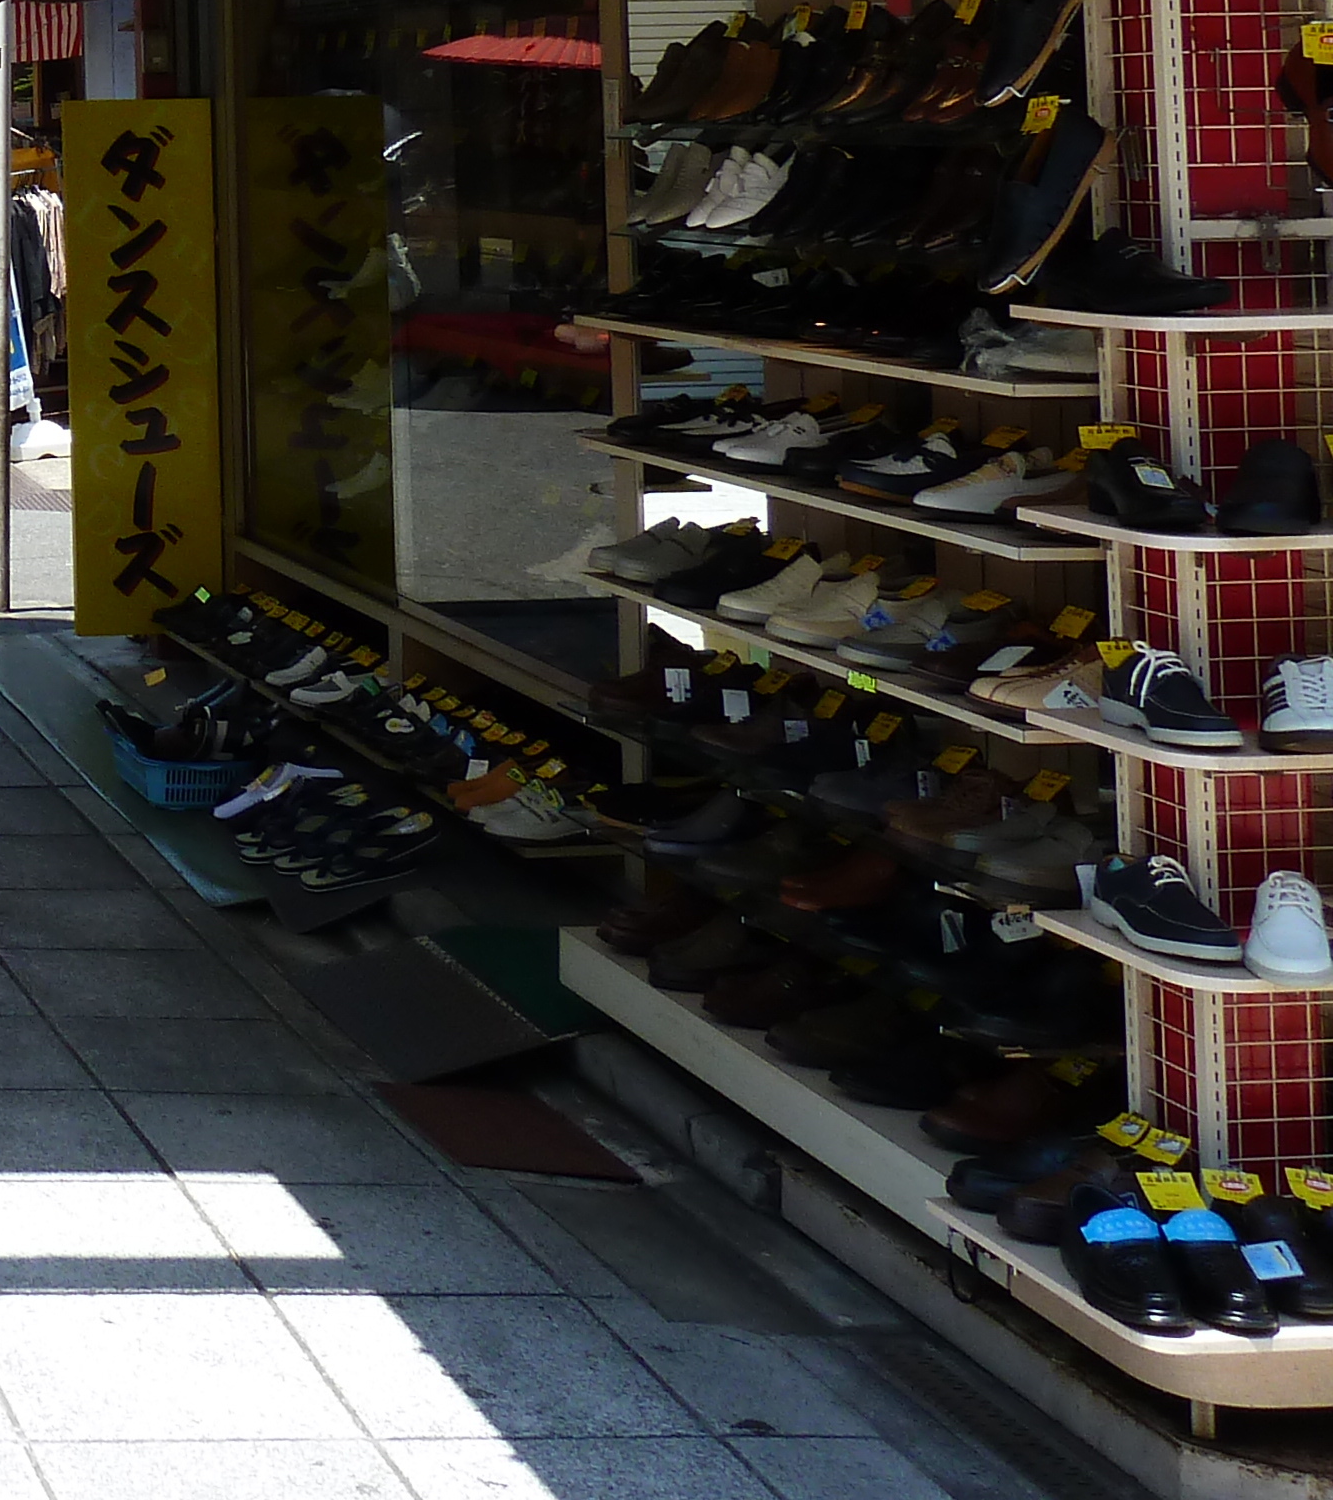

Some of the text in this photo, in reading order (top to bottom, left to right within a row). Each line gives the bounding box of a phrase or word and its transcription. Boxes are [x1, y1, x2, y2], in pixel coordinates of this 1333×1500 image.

[100, 124, 183, 599] ダンスシューズ
